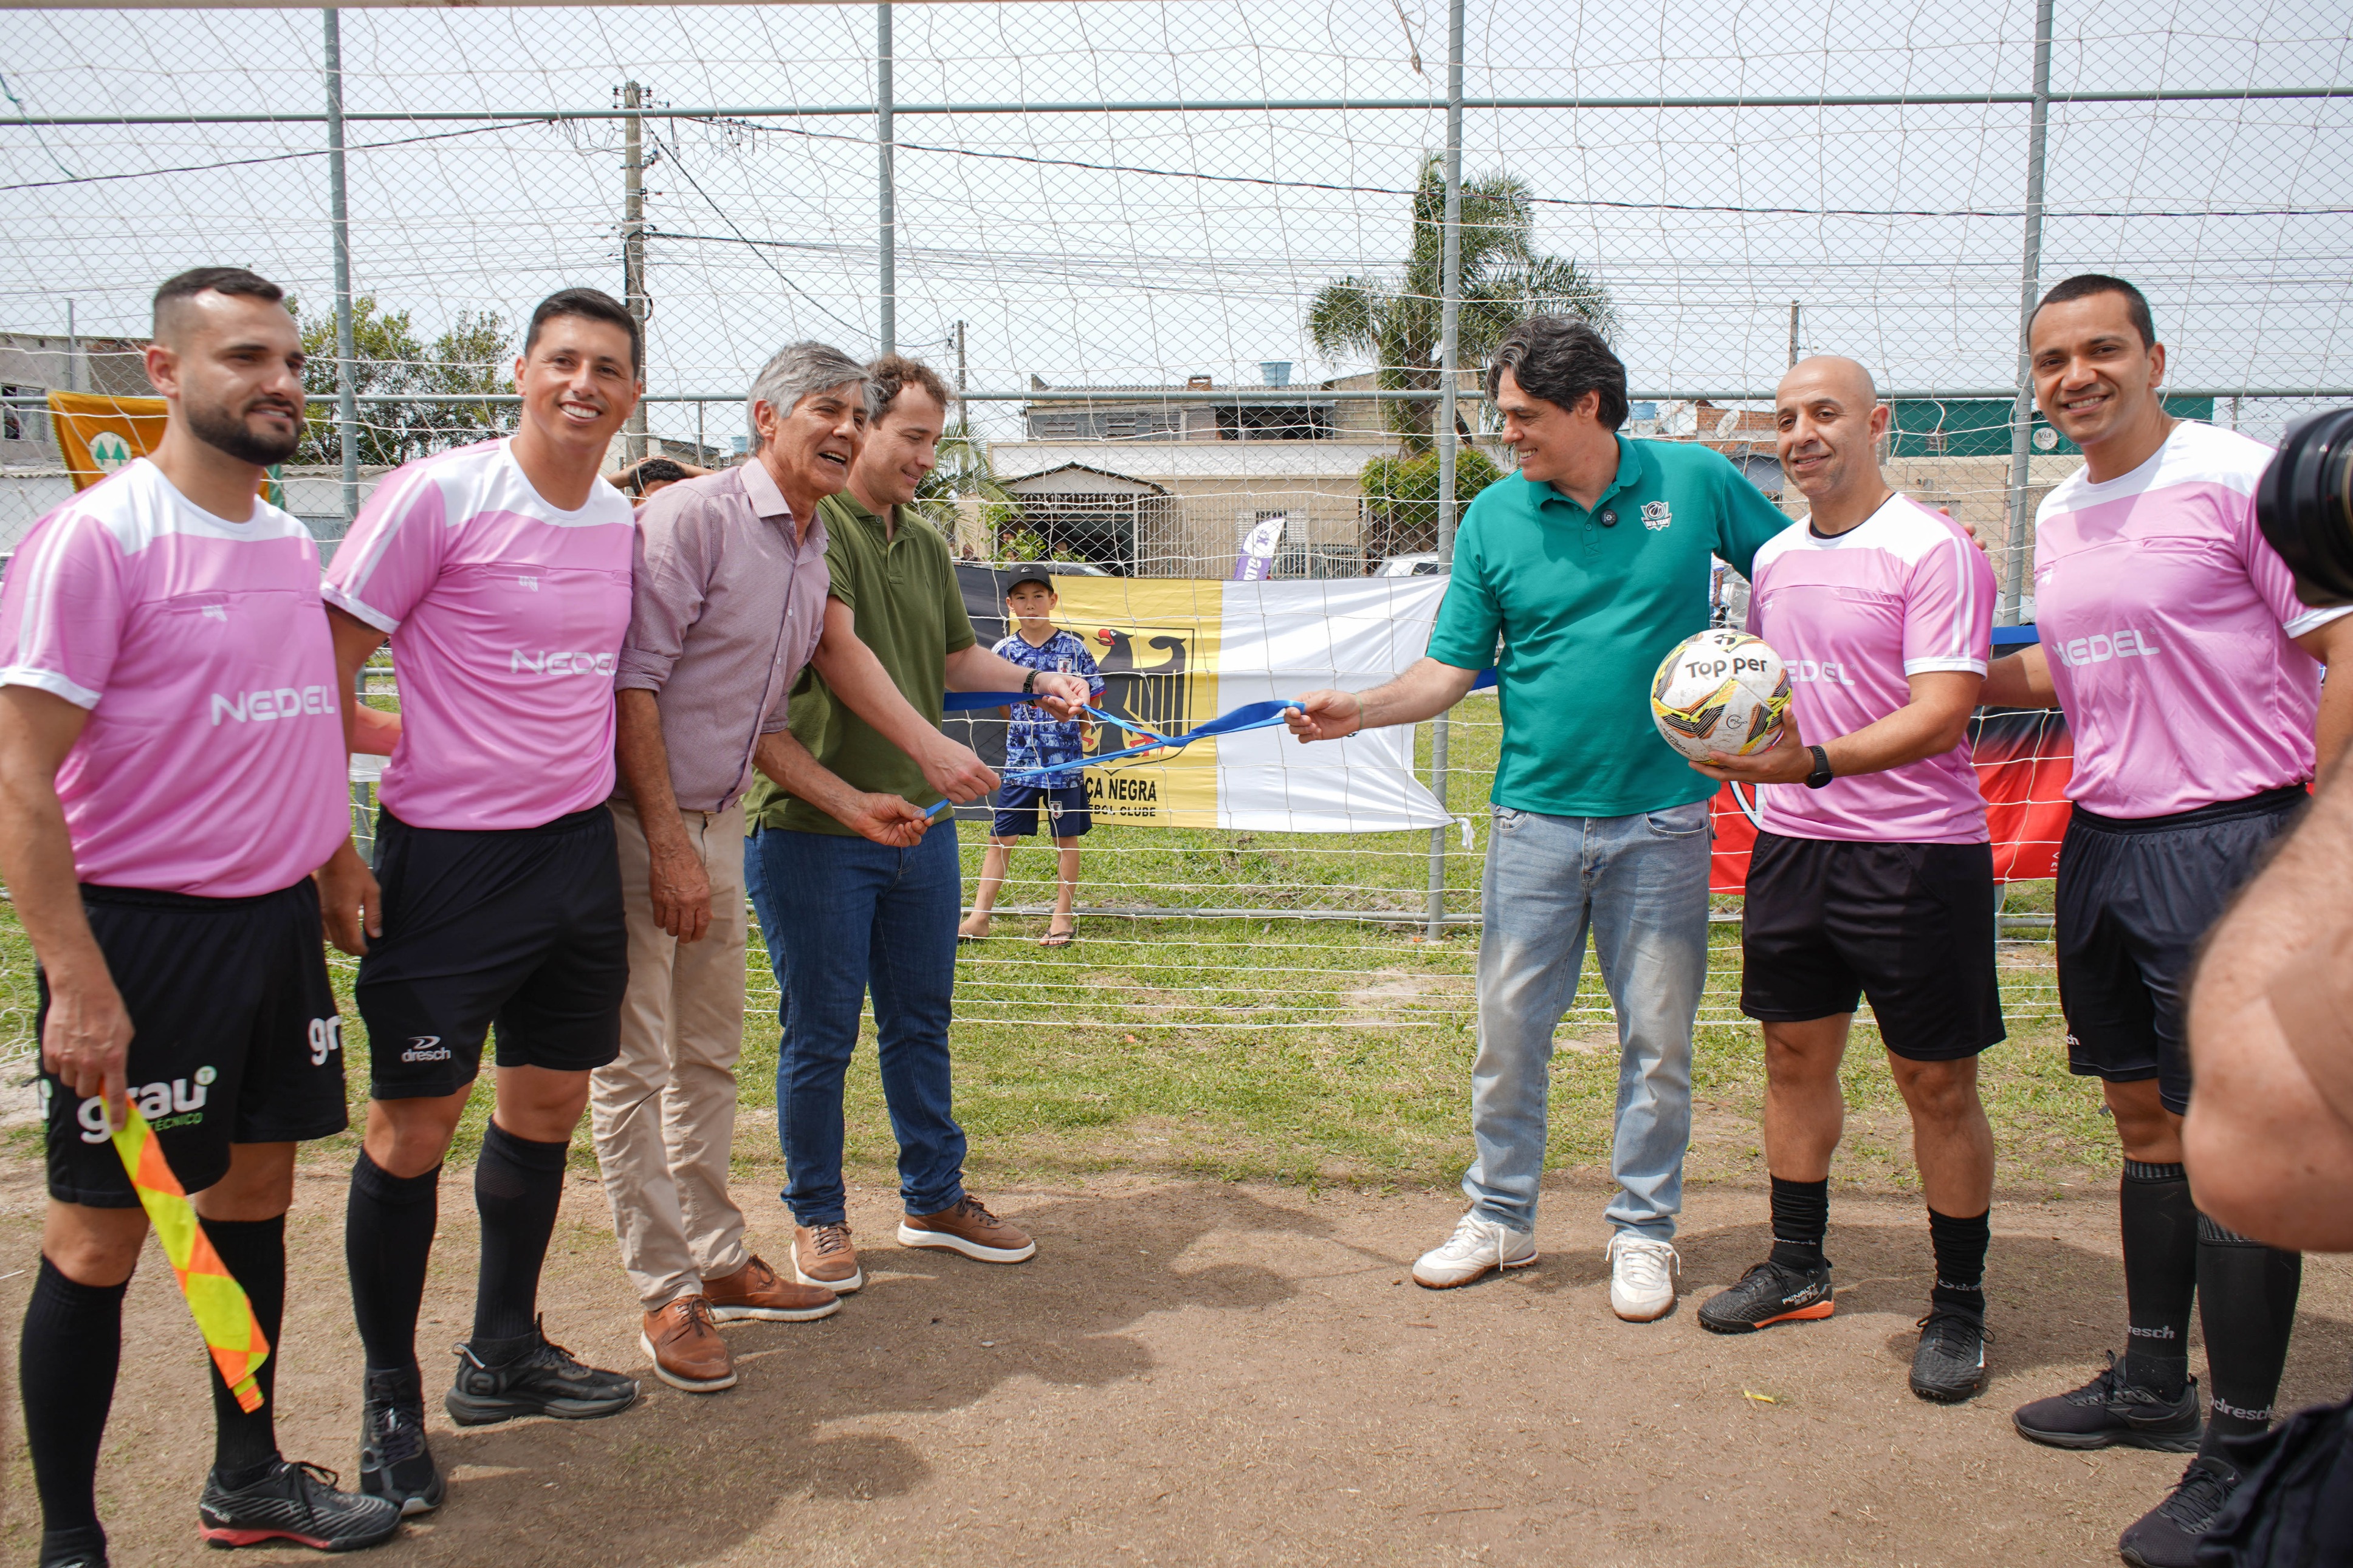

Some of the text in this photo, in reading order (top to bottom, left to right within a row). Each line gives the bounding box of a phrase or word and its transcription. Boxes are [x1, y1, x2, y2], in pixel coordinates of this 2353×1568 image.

[2052, 630, 2160, 668] NEDEL
[211, 685, 335, 726] NEDEL
[1108, 778, 1157, 801] NEGRA
[1120, 806, 1156, 817] CLUBE
[401, 1047, 451, 1062] dresch
[148, 1112, 203, 1132] ÉCNICO
